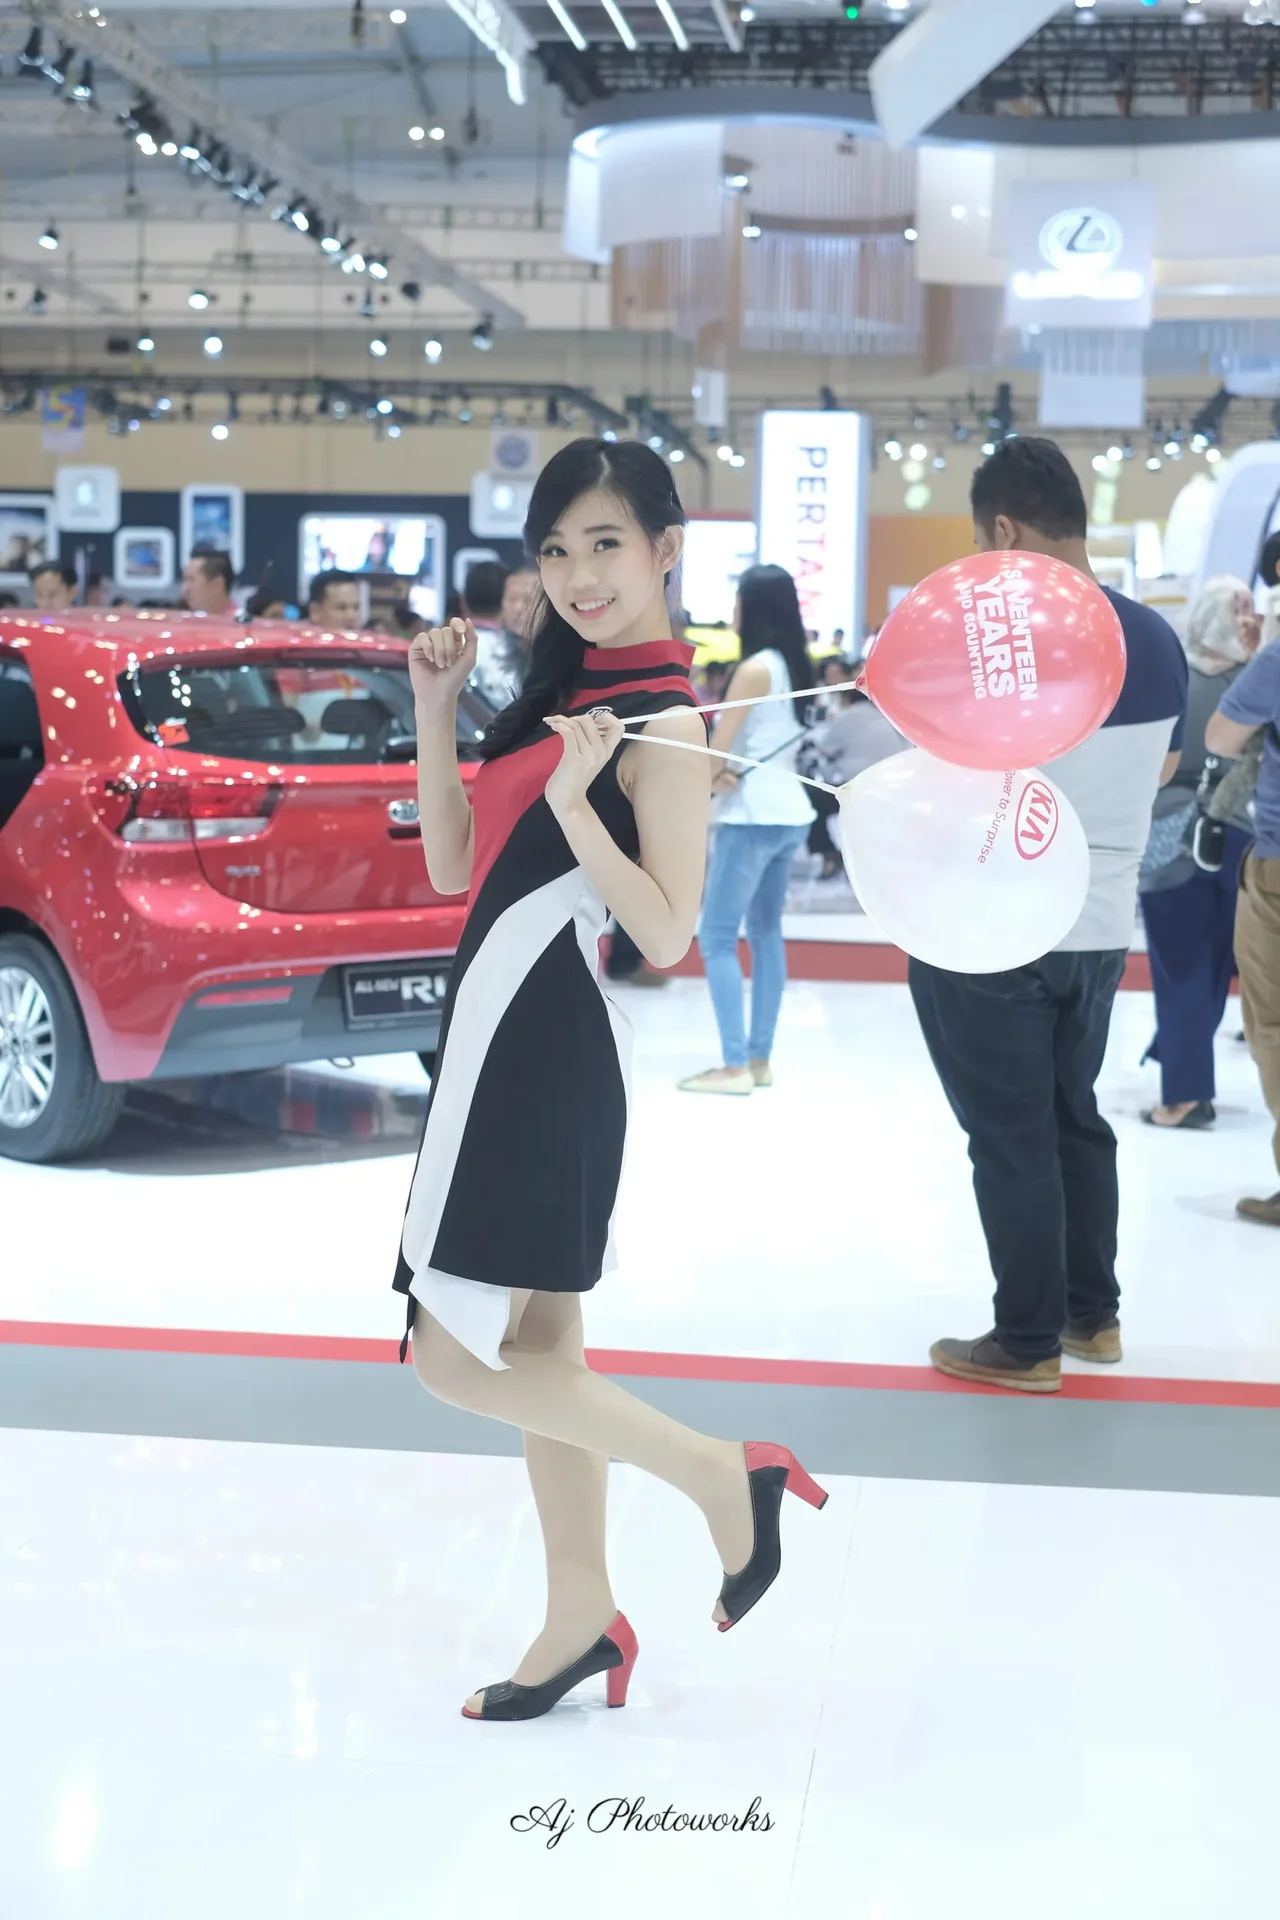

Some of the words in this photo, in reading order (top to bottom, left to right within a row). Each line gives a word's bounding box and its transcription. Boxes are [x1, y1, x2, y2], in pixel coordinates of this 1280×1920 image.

[963, 612, 987, 699] COUNTING
[974, 574, 1015, 698] YEARS
[1003, 569, 1038, 701] SVENTEEN
[999, 798, 1010, 810] to
[1020, 788, 1052, 842] KIA
[978, 812, 1006, 863] Surprise
[401, 975, 446, 1004] RI
